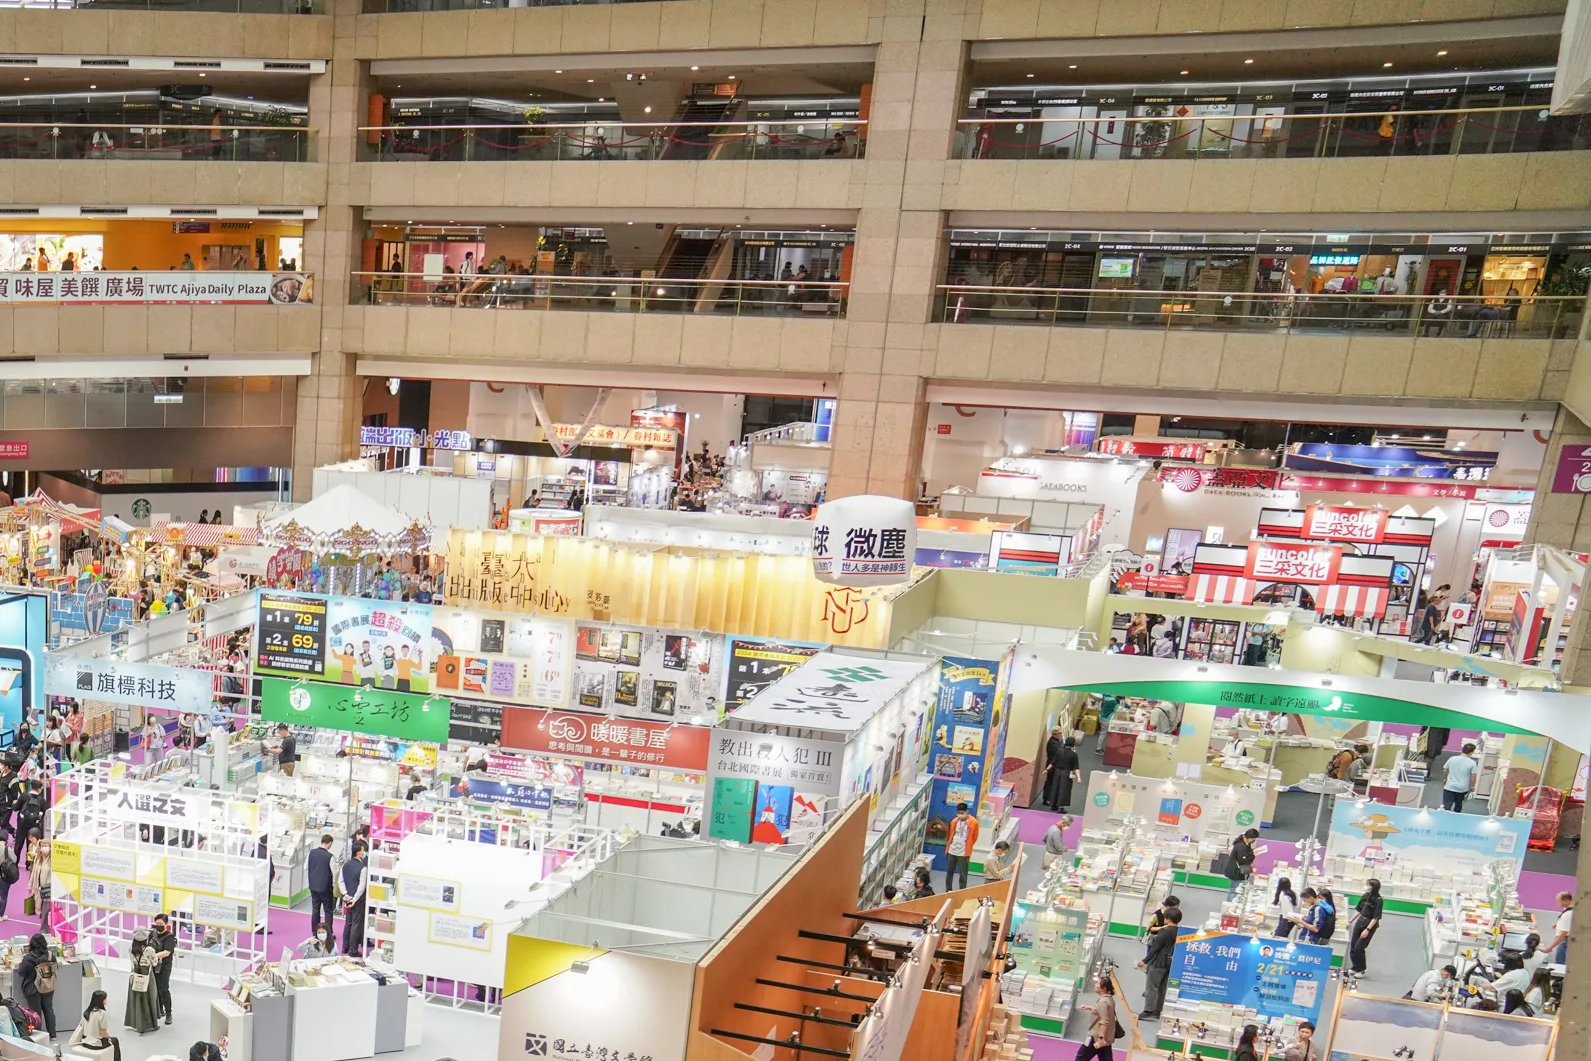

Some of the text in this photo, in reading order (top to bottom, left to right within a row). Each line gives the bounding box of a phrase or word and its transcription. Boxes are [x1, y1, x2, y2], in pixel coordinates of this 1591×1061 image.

[148, 284, 178, 295] TWTC
[180, 283, 207, 297] Ajiya
[207, 283, 235, 297] Daily
[237, 283, 267, 294] Plaza
[1311, 521, 1374, 539] 三采文化
[844, 527, 907, 559] 微塵
[1255, 558, 1326, 578] 三采文化
[97, 672, 176, 701] 旗標科技
[590, 722, 667, 749] 暖暖書屋
[716, 760, 783, 778] 台北國際書展
[1186, 940, 1242, 959] 拯救 我們
[1184, 954, 1238, 972] 自 由
[1256, 962, 1285, 976] 2/21
